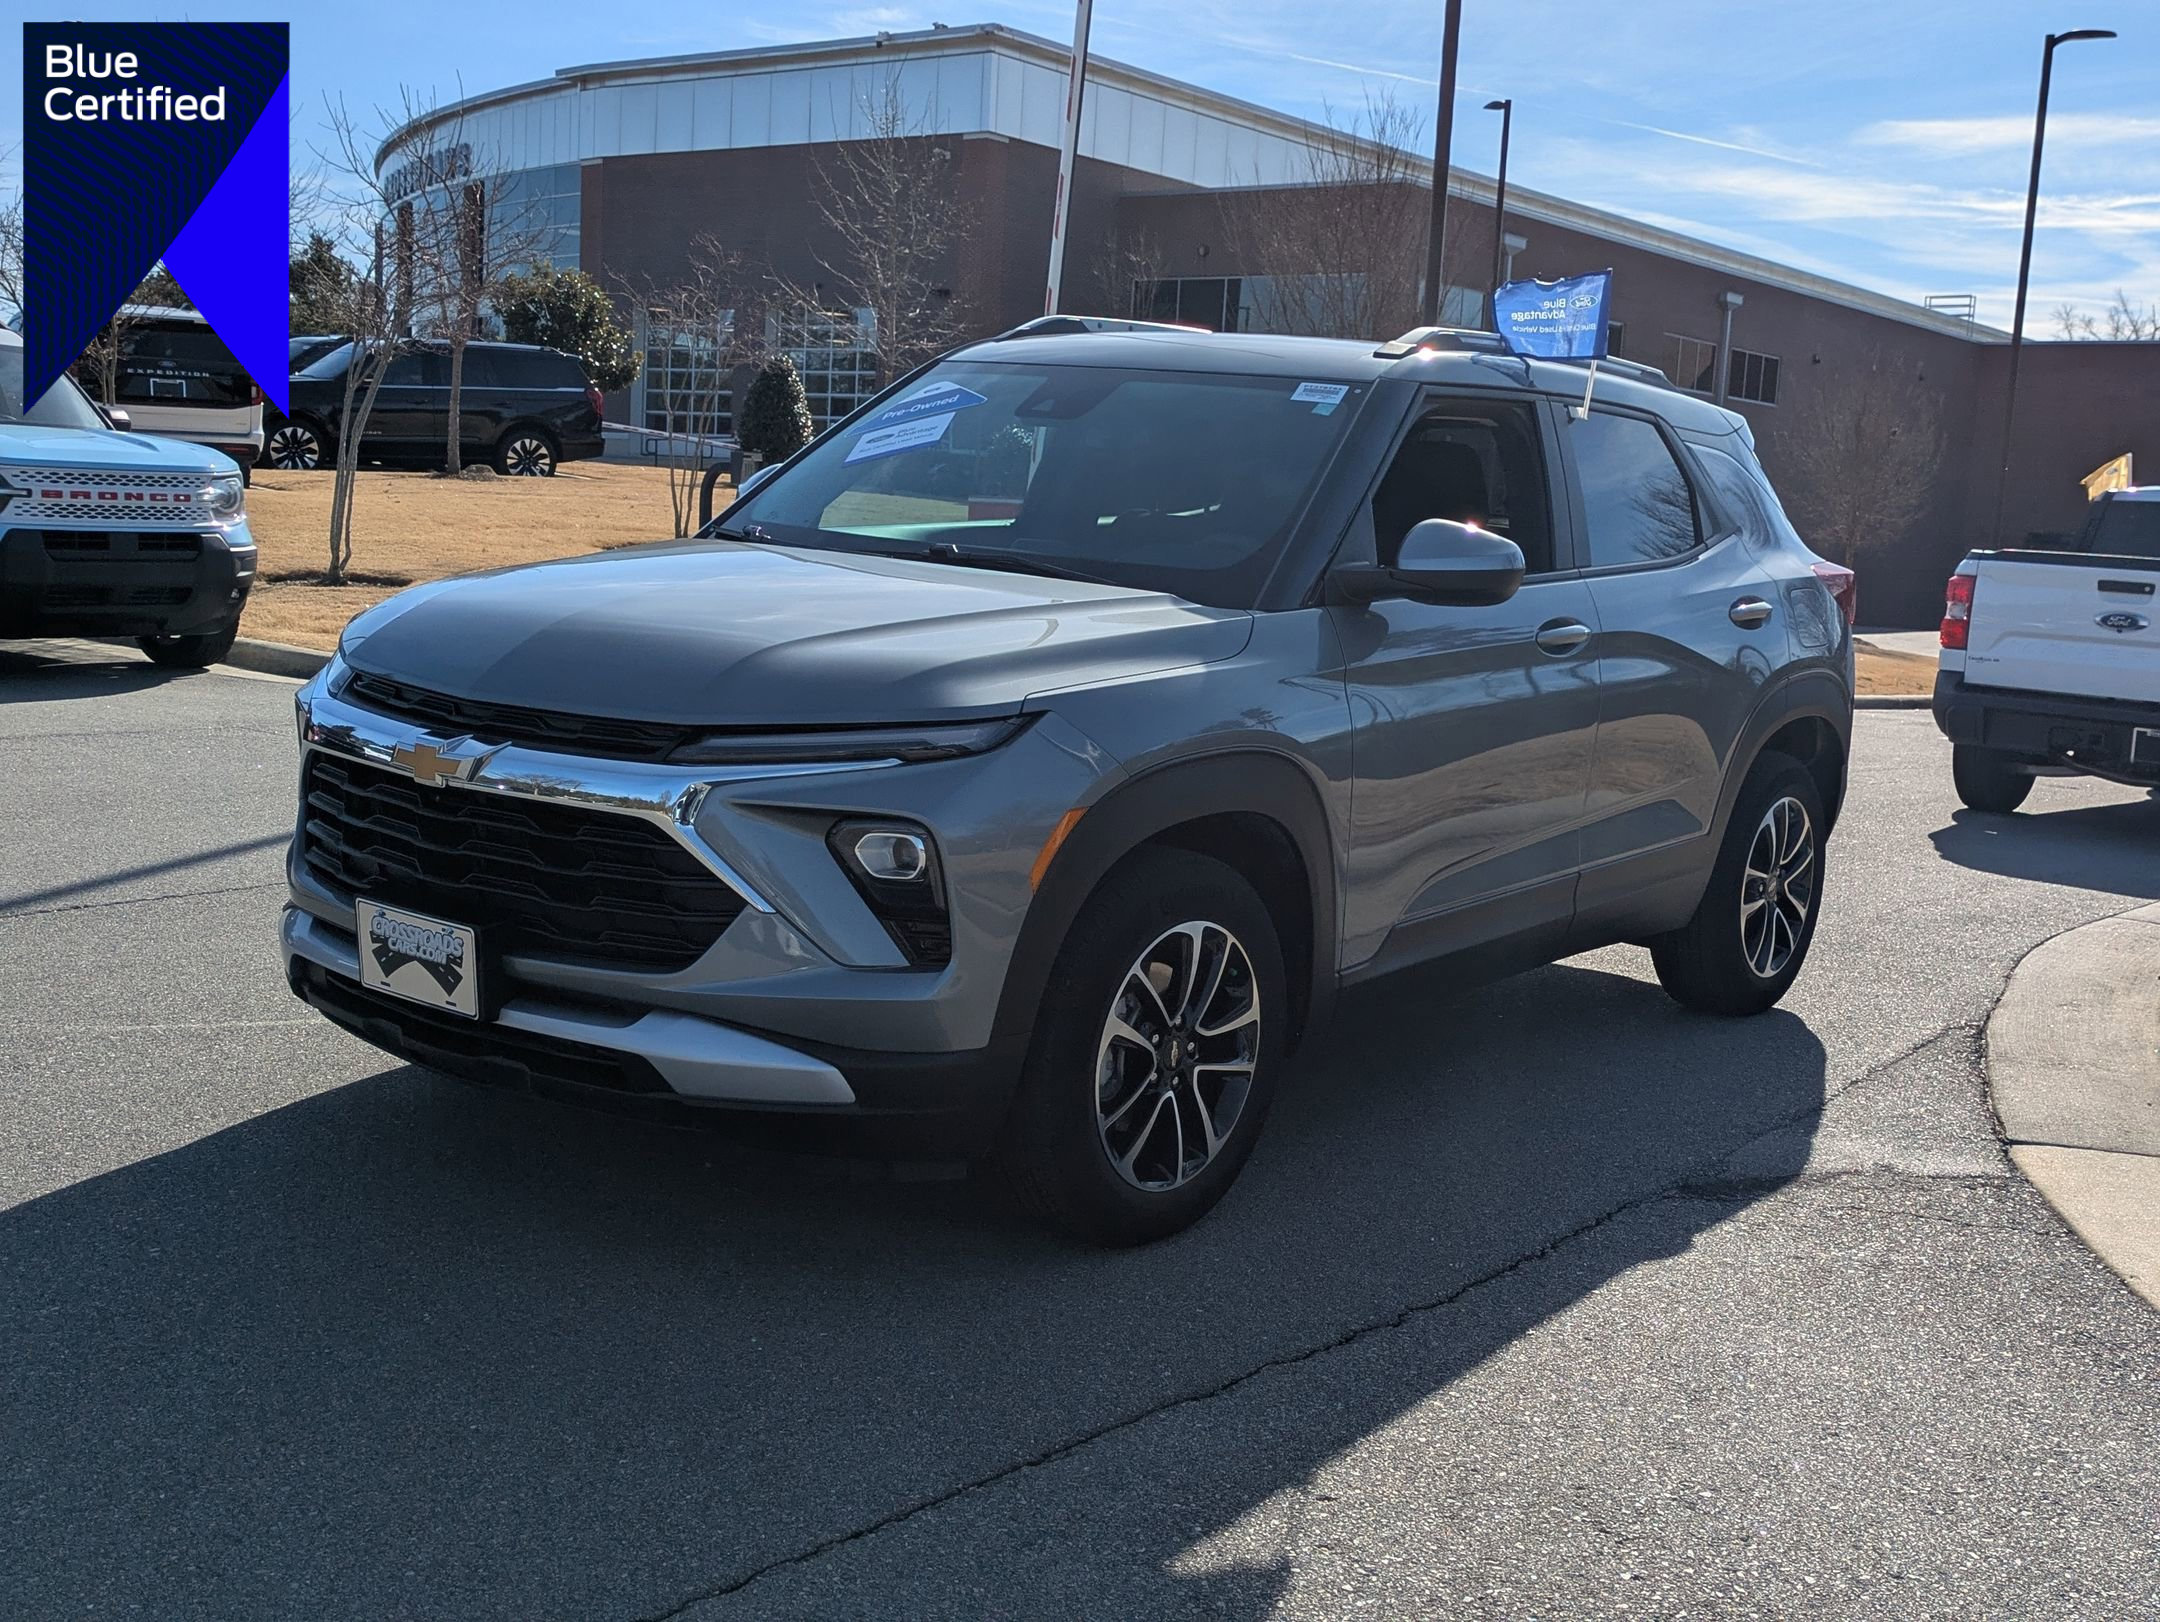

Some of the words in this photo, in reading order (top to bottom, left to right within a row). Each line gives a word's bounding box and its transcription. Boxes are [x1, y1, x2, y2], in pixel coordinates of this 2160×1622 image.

[127, 368, 210, 377] EXPEDITION
[881, 394, 960, 420] Pre-Owned
[41, 489, 191, 503] BRONCO
[371, 914, 465, 958] CROSSROADS
[388, 937, 447, 965] CARS.COM
